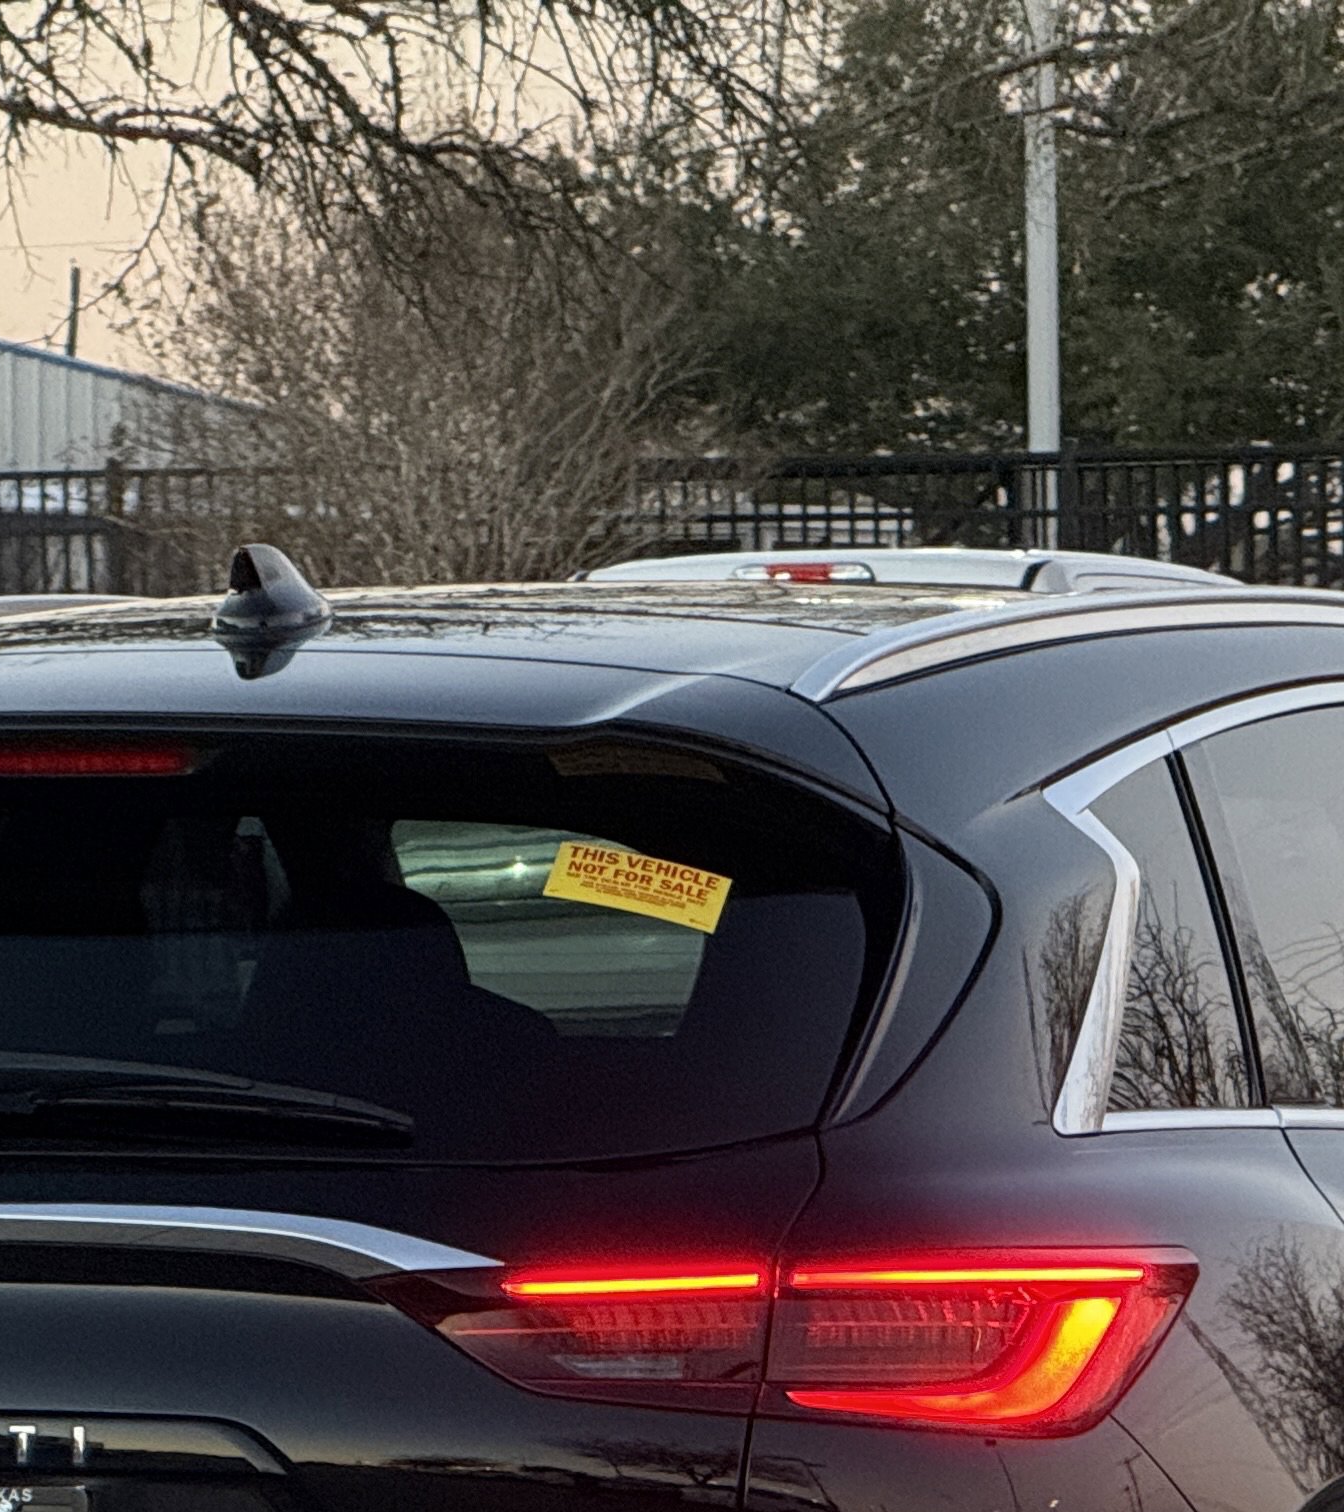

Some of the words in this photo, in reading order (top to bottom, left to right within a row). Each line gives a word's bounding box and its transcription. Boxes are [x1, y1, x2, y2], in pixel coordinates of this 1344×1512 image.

[567, 860, 609, 877] NOT
[613, 868, 654, 886] FOR
[659, 879, 712, 901] SALE
[570, 845, 620, 865] THIS
[626, 855, 721, 890] VEHICLE
